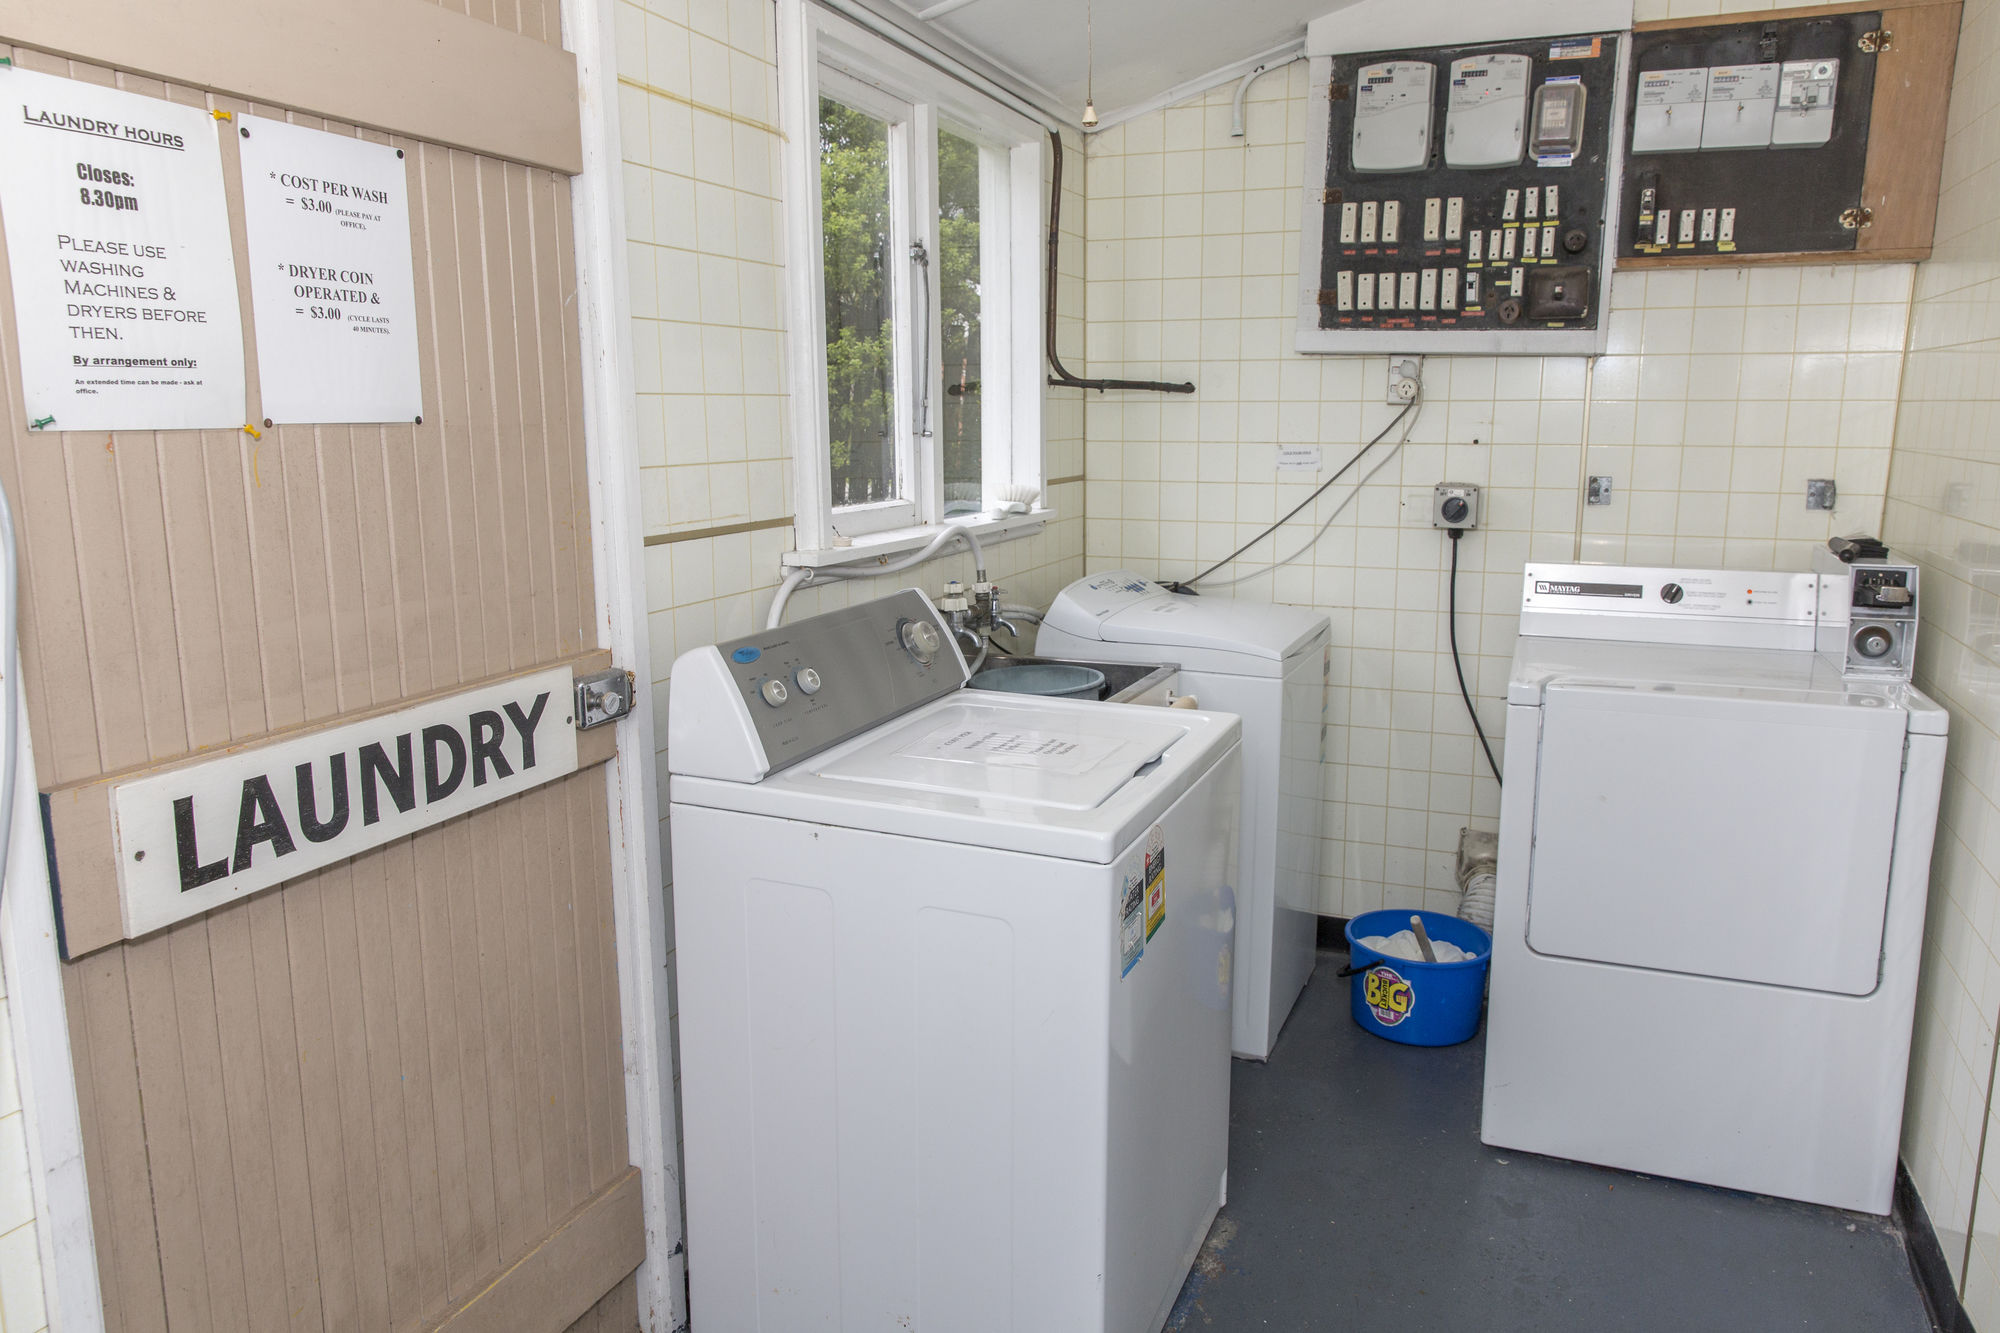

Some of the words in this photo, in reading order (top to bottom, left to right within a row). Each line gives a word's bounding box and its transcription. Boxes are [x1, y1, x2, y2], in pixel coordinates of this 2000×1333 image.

[23, 105, 119, 136] LAUNDRY
[125, 125, 184, 148] HOURS
[76, 162, 135, 187] Closes:
[80, 188, 139, 211] 8.30pm
[280, 173, 319, 192] COST
[322, 180, 349, 198] PER
[351, 186, 389, 205] WASH
[301, 197, 332, 214] $3.00
[57, 234, 129, 256] PLEASE
[133, 244, 167, 259] USE
[60, 259, 145, 278] WASHING
[288, 263, 338, 283] DRYER
[340, 270, 374, 286] COIN
[64, 279, 159, 301] MACHINES
[163, 286, 177, 301] &
[293, 284, 367, 304] OPERATED
[370, 292, 381, 305] &
[67, 304, 138, 320] DRYERS
[142, 308, 207, 323] BEFORE
[310, 305, 341, 321] $3.00
[68, 326, 124, 340] THEN.
[73, 355, 89, 367] By
[93, 356, 168, 367] arrangement
[171, 356, 198, 368] only:
[1549, 585, 1580, 593] MAYTAG
[173, 691, 551, 893] LAUNDRY
[1366, 972, 1409, 1012] BIG
